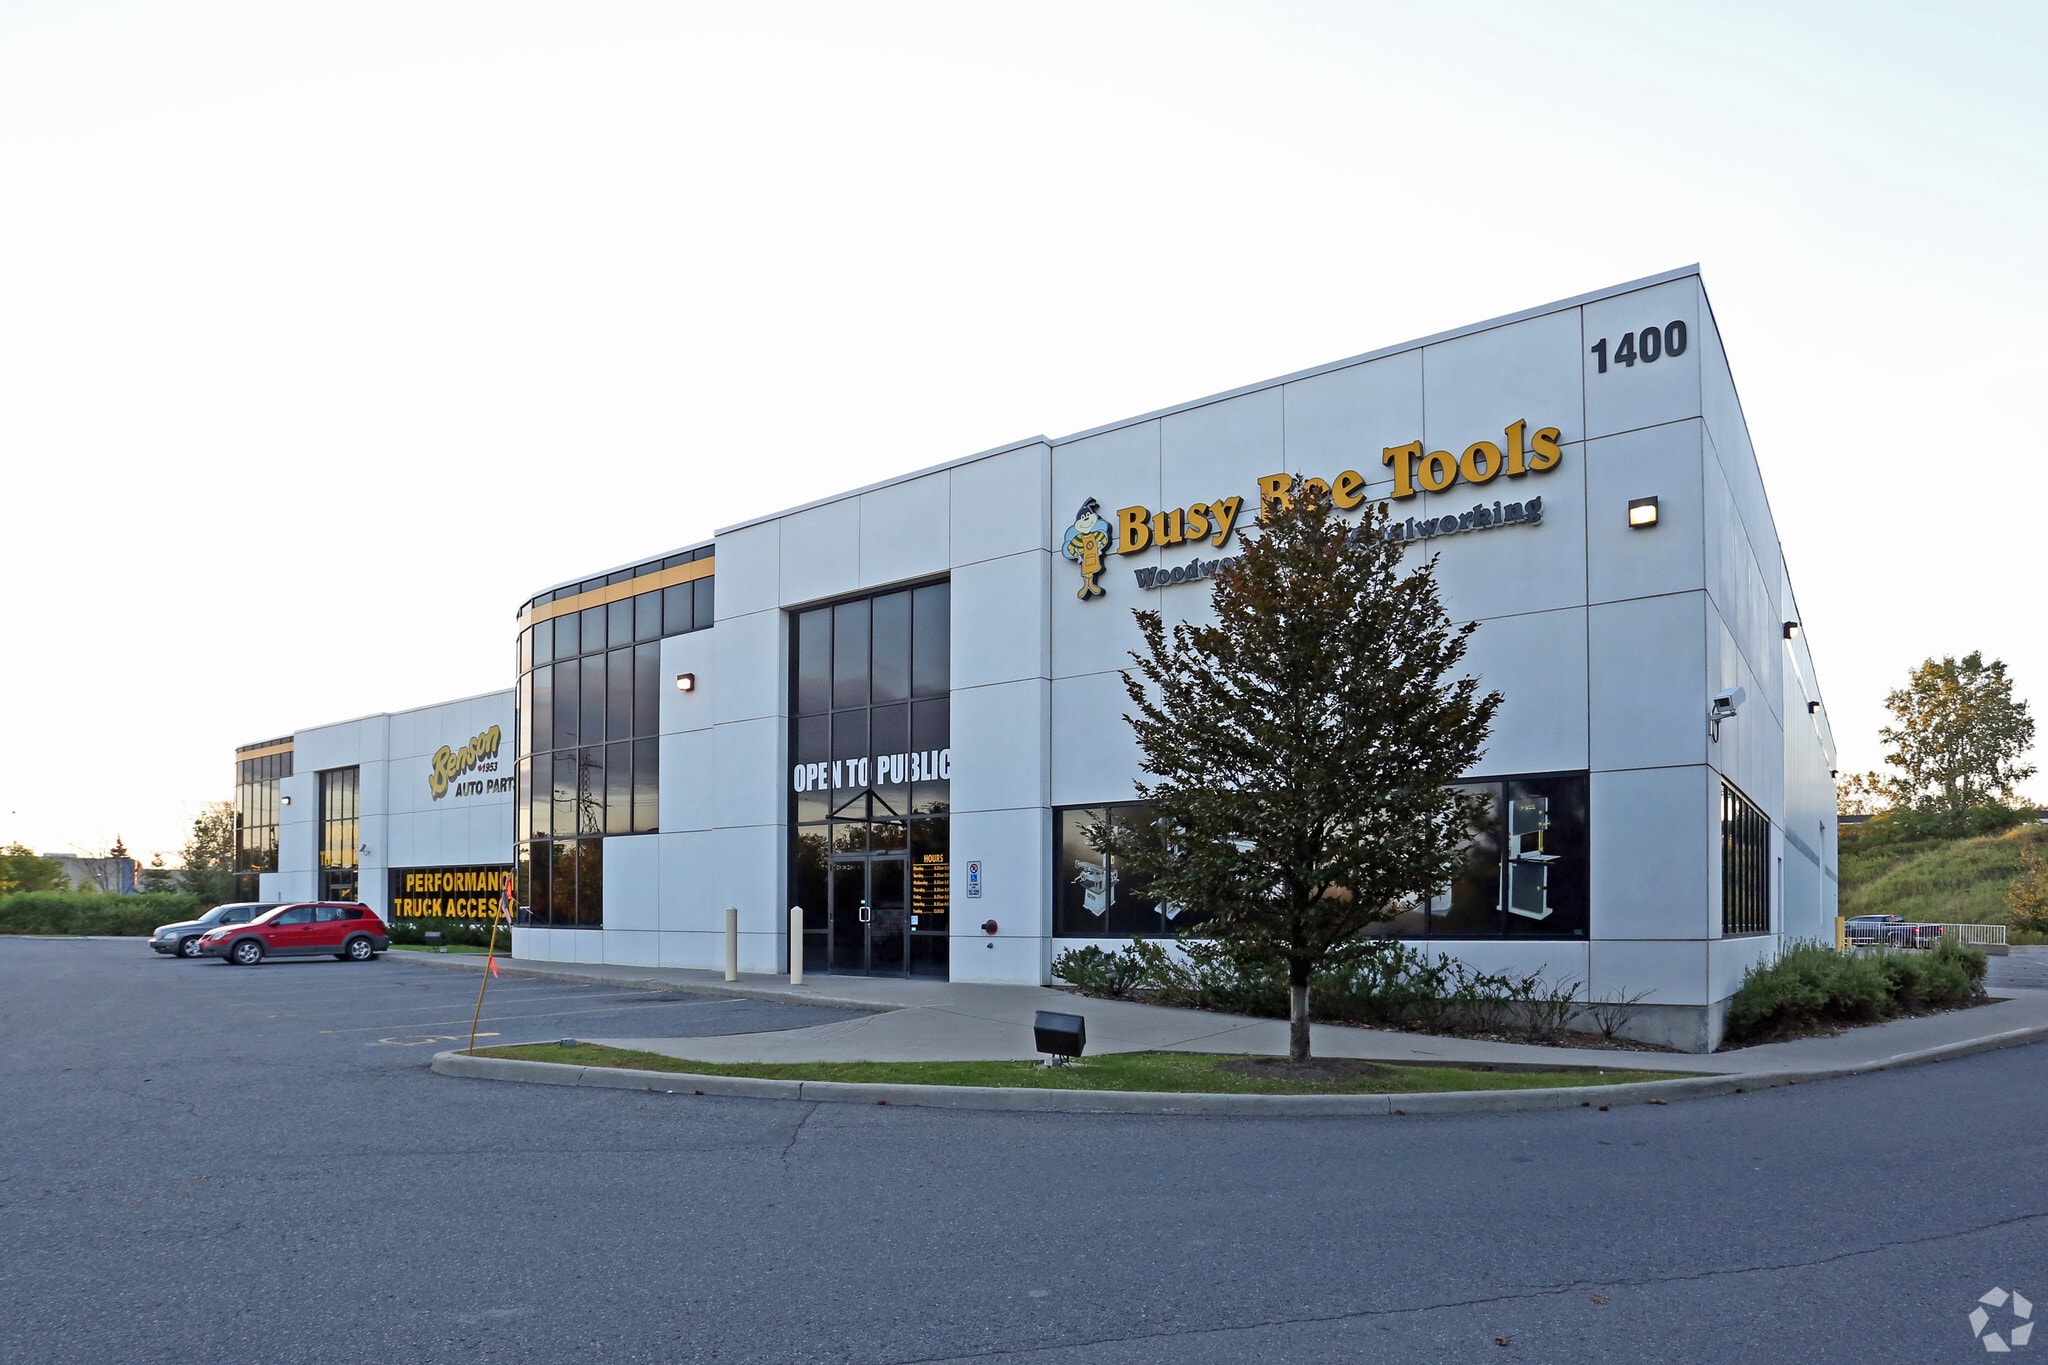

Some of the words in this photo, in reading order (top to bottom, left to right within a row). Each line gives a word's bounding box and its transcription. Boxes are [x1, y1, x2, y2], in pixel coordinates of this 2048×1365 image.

[1591, 320, 1687, 374] 1400
[1116, 496, 1243, 556] Busy
[1382, 418, 1563, 501] Tools
[1345, 496, 1544, 551] alworking
[428, 724, 501, 802] Benson
[482, 761, 498, 773] 1953
[793, 760, 842, 793] OPEN
[846, 757, 873, 788] TO
[877, 748, 950, 785] PUBLIC
[455, 780, 484, 797] AUTO
[486, 776, 515, 794] PART
[923, 854, 944, 863] HOURS
[394, 898, 442, 918] TRUCK
[445, 898, 515, 919] ACCES
